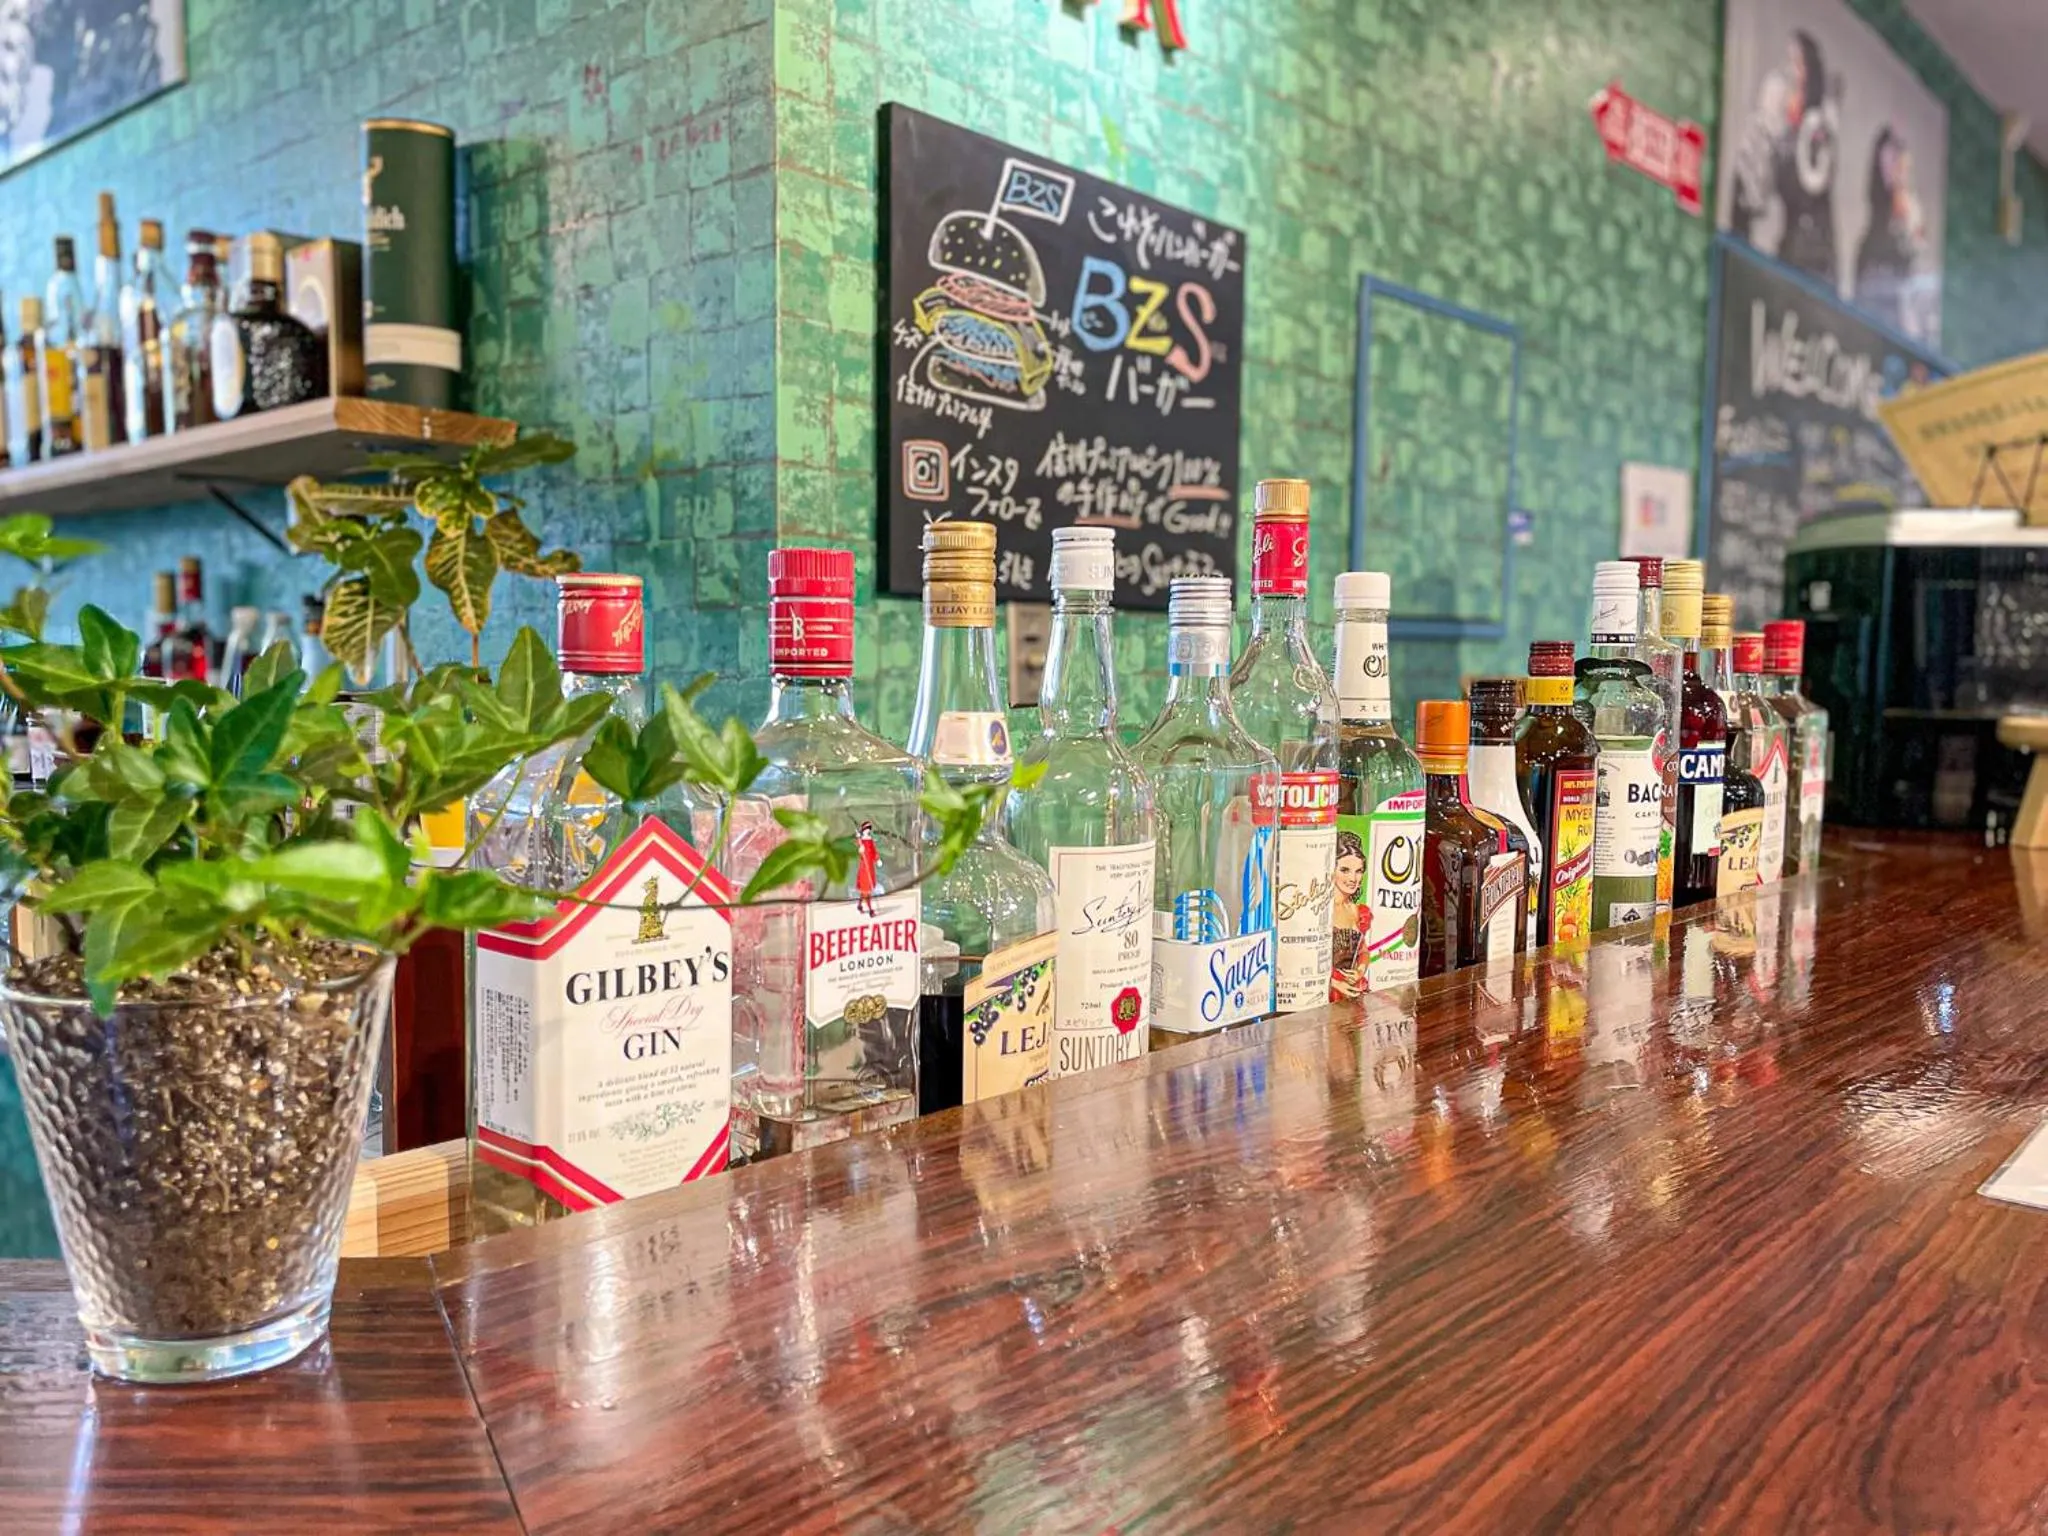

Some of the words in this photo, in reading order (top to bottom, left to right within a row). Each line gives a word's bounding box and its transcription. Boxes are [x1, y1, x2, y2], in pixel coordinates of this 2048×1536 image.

[1007, 173, 1062, 216] BZS
[1072, 256, 1217, 383] BZS
[951, 443, 1020, 494] インスタ
[775, 648, 829, 658] IMPORTED
[810, 918, 918, 971] BEEFEATER
[1124, 930, 1139, 949] 80
[565, 945, 729, 1006] GILBEY'S
[840, 954, 894, 973] LONDON
[1201, 937, 1270, 1022] Sauza
[623, 1027, 682, 1061] GIN
[1000, 1021, 1048, 1056] LEJ
[1060, 1032, 1132, 1072] SUNTORY
